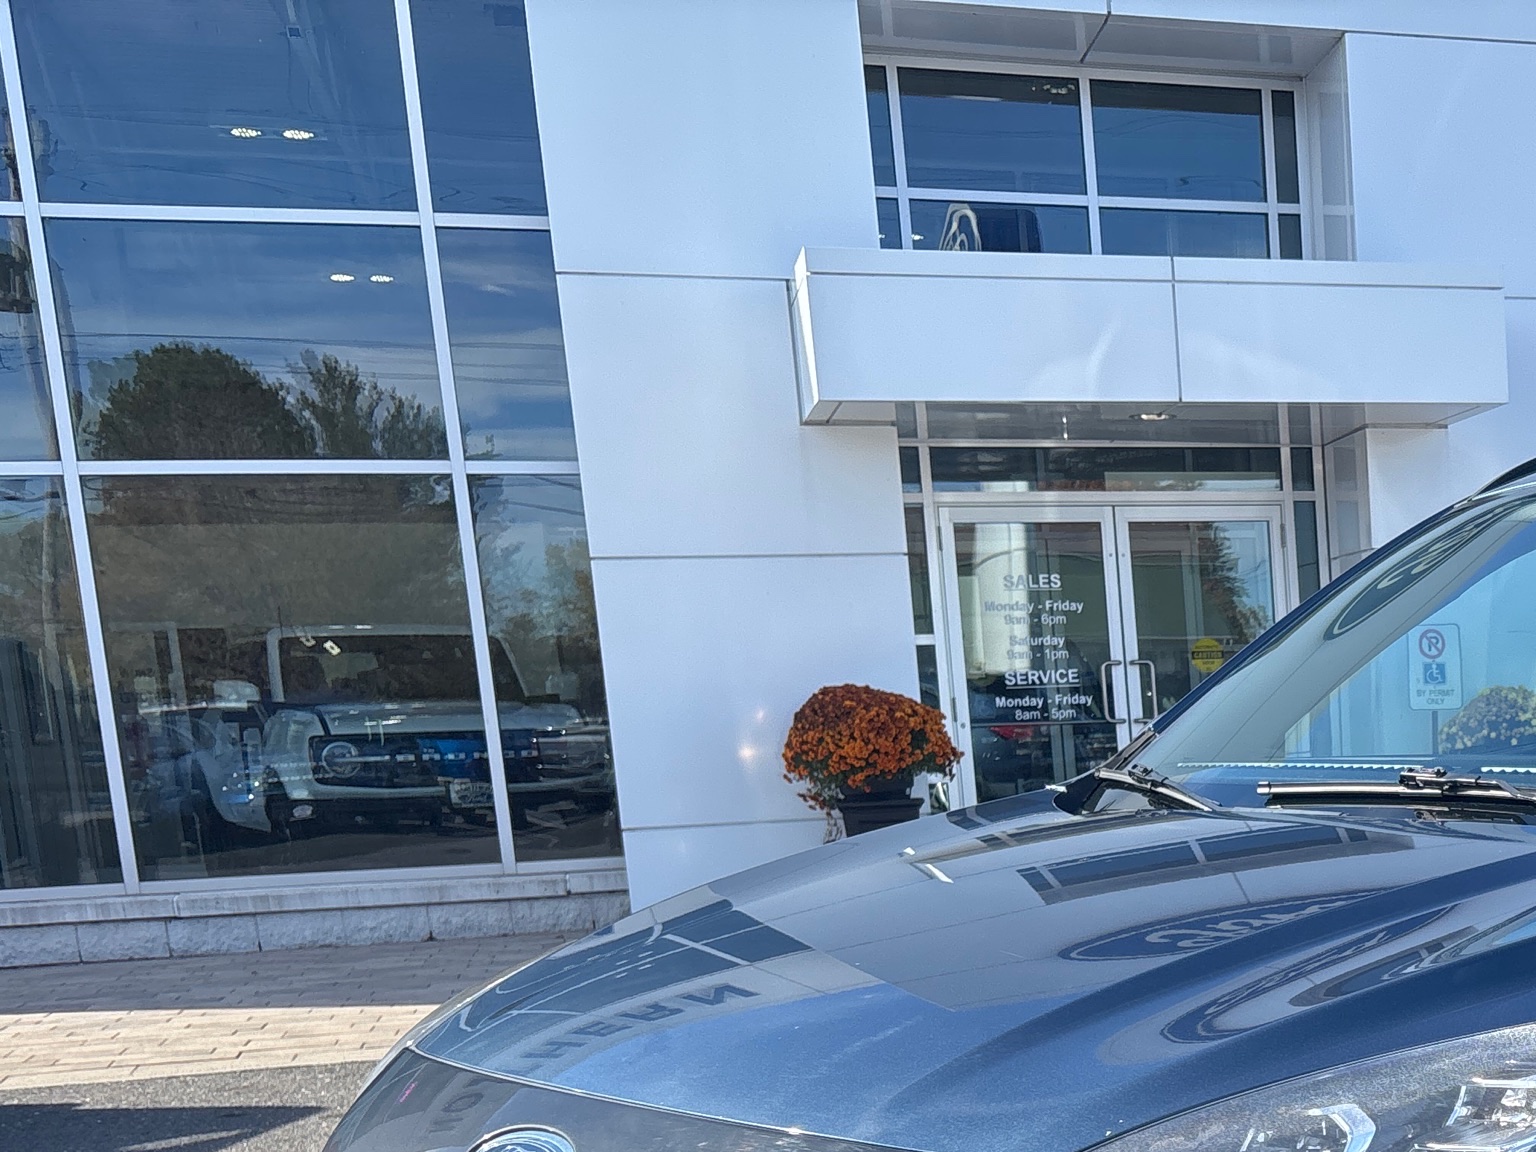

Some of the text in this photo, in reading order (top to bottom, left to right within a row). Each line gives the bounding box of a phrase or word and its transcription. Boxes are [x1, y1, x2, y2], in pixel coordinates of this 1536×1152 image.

[1003, 574, 1062, 588] SALES
[984, 600, 1034, 613] Monday
[1045, 600, 1084, 614] Friday
[1004, 614, 1030, 625] 9am
[1041, 614, 1067, 627] 6pm
[1009, 635, 1065, 648] Saturday
[1007, 650, 1033, 661] 9am
[1045, 649, 1069, 662] 1pm
[1005, 668, 1080, 686] SERVICE
[1416, 689, 1426, 697] BY
[995, 696, 1044, 708] Monday
[1055, 694, 1093, 707] Friday
[1426, 697, 1445, 705] ONLY
[1015, 709, 1040, 721] 8am
[1051, 709, 1076, 721] 5pm
